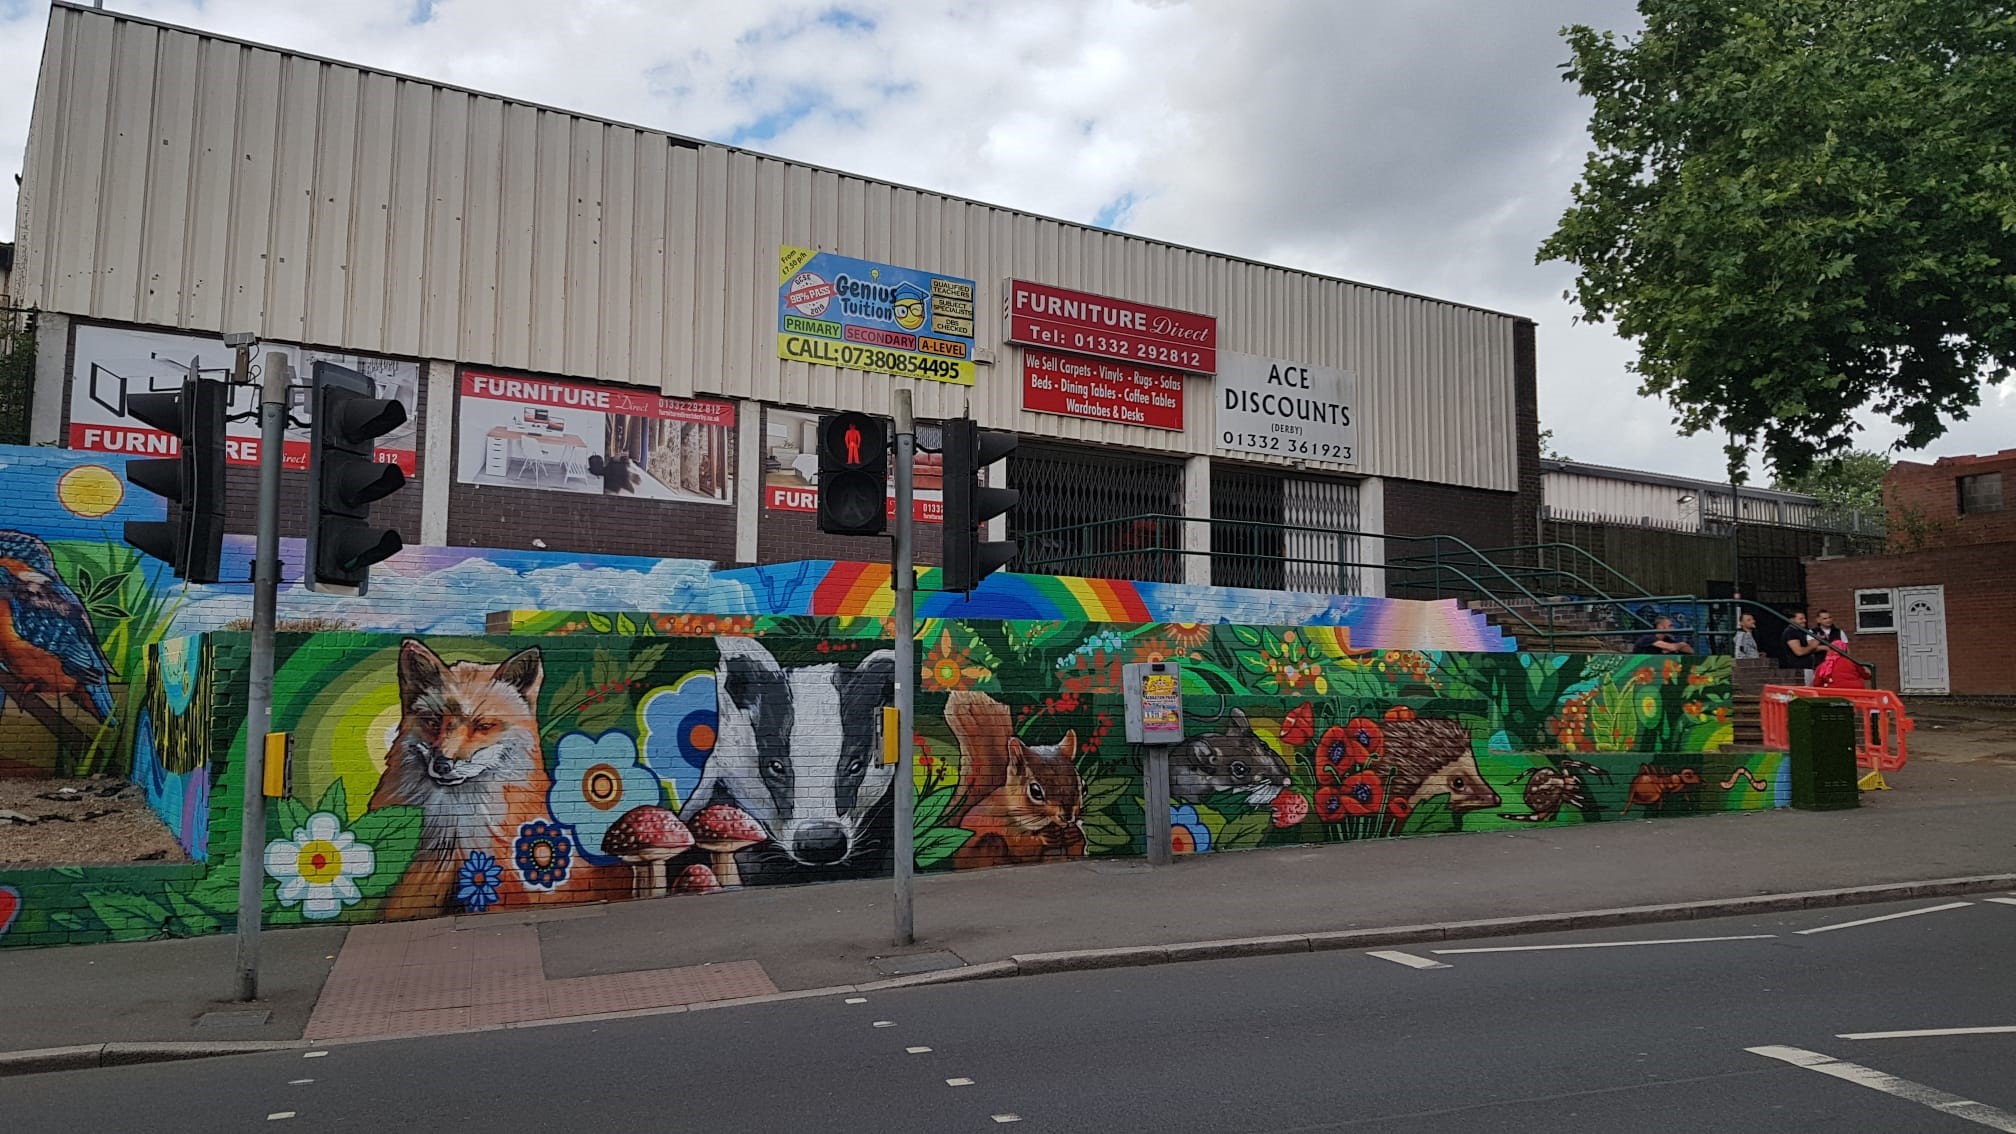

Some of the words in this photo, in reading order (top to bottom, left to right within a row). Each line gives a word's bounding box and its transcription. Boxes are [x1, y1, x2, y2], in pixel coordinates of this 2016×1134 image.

[781, 250, 797, 264] From
[809, 286, 831, 299] PASS
[836, 275, 897, 304] Genius
[933, 281, 970, 293] QUALIFIED
[933, 287, 970, 298] TEACHERS
[841, 297, 893, 321] Tuition
[933, 304, 972, 316] SPECIALISTS
[939, 300, 967, 309] SUBJECT
[1016, 290, 1147, 331] FURNITURE
[1150, 315, 1209, 342] Direct
[786, 318, 839, 336] PRIMARY
[937, 324, 968, 333] CHECKED
[847, 328, 915, 348] SECONDARY
[922, 340, 964, 356] A-LEVEL
[1029, 325, 1065, 344] Tel:
[1075, 333, 1129, 355] 01332
[1137, 344, 1200, 366] 292812
[786, 337, 838, 362] CALL:
[841, 346, 959, 379] 07380854495
[1026, 353, 1040, 369] We
[1042, 356, 1057, 372] Sell
[1060, 359, 1091, 378] Carpets
[1099, 365, 1124, 384] Vinyls
[1134, 371, 1153, 389] Rugs
[1160, 375, 1181, 391] Sofas
[1267, 363, 1310, 389] ACE
[473, 376, 610, 409] FURNITURE
[615, 395, 649, 412] Direct
[1032, 374, 1052, 390] Beds
[1061, 378, 1088, 398] Dining
[1090, 383, 1116, 399] Tables
[1124, 388, 1149, 405] Coffee
[1151, 392, 1176, 408] Tables
[659, 399, 686, 411] 01332
[687, 402, 704, 413] 292
[705, 404, 721, 414] 812
[1066, 398, 1111, 417] Wardrobes
[1113, 405, 1120, 418] &
[1121, 407, 1145, 422] Desks
[1225, 388, 1350, 427] DISCOUNTS
[1271, 423, 1303, 436] (DERBY)
[1223, 431, 1279, 450] 01332
[1288, 439, 1351, 459] 361923
[379, 452, 398, 464] 812
